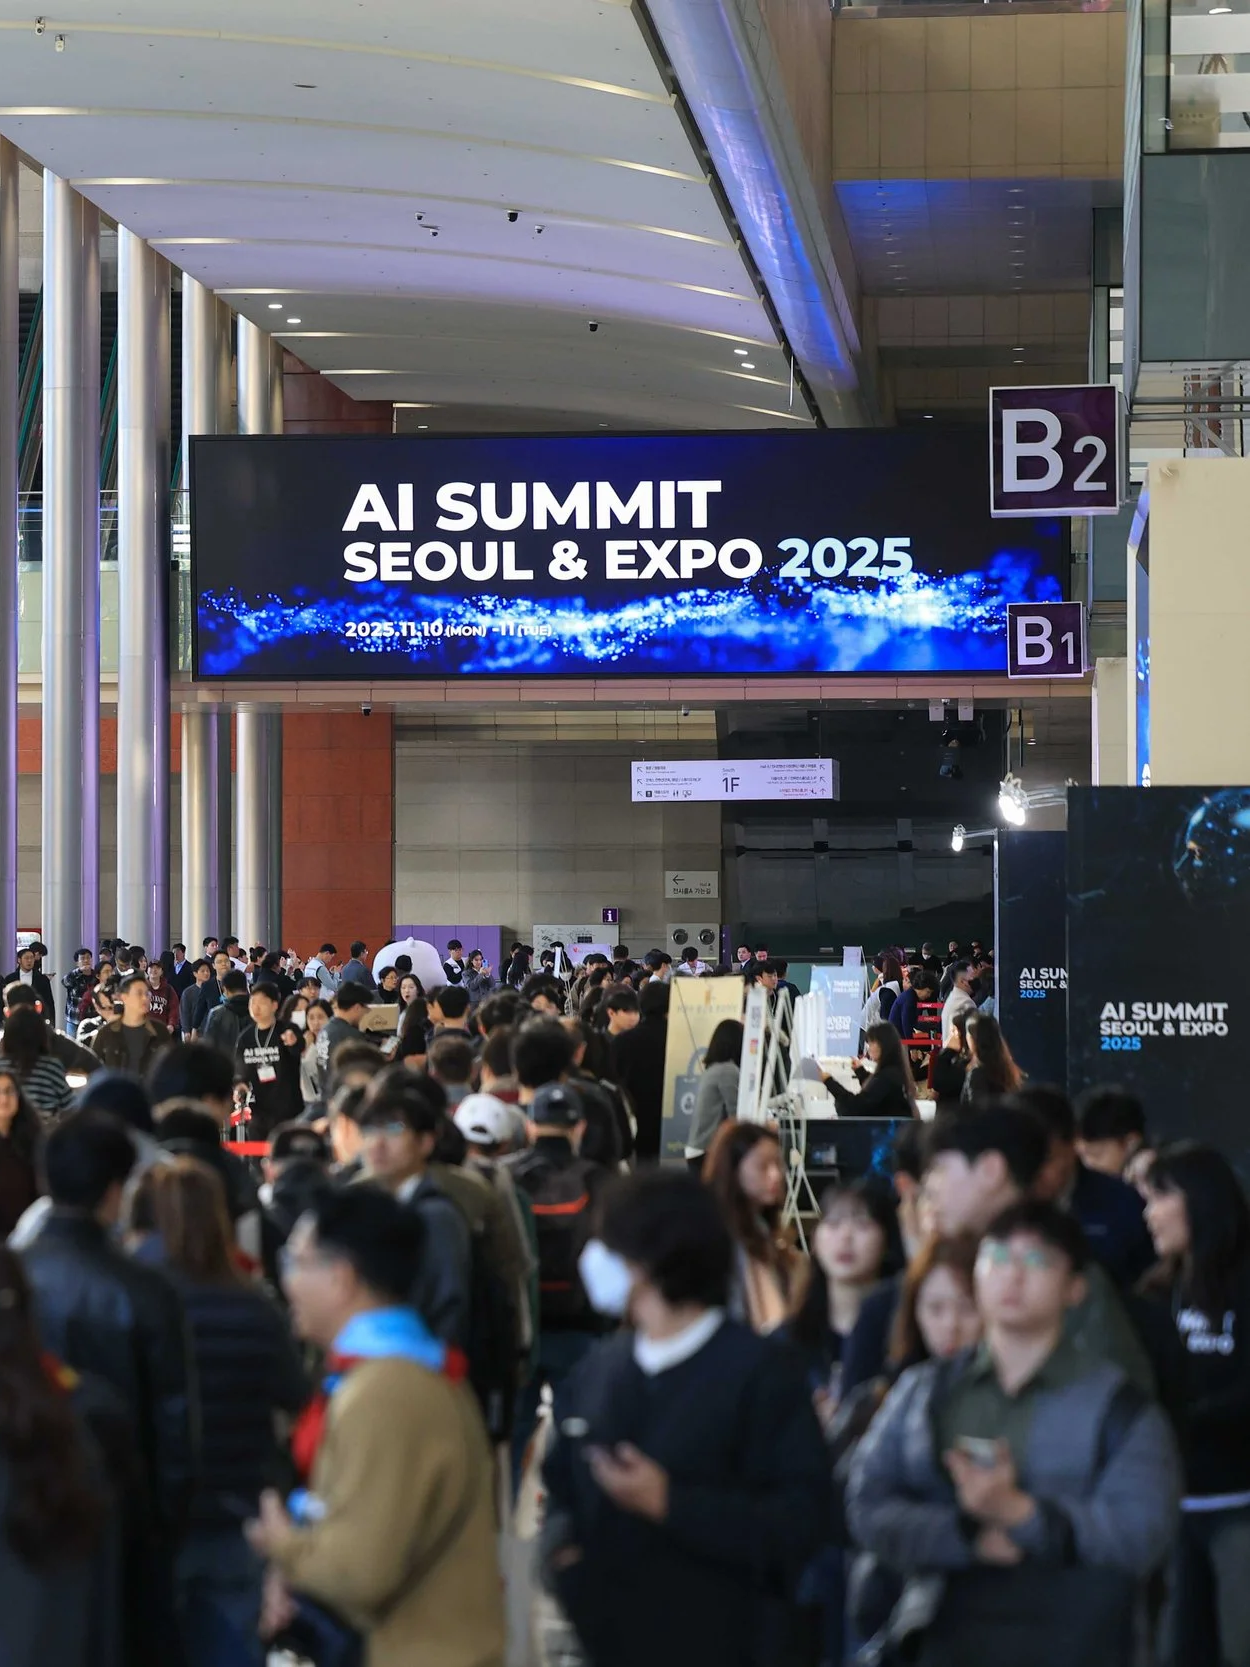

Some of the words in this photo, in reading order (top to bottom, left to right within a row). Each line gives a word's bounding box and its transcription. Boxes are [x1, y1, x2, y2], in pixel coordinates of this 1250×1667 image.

[1002, 408, 1107, 493] B2
[341, 482, 414, 532] AI
[435, 480, 722, 532] SUMMIT
[343, 540, 534, 583] SEOUL
[548, 539, 589, 581] &
[605, 539, 763, 580] EXPO
[777, 537, 913, 579] 2025
[1017, 615, 1075, 666] B1
[722, 777, 740, 792] 1F
[1019, 968, 1036, 979] AI
[1019, 980, 1058, 989] SEOUL
[1020, 989, 1046, 998] 2025
[1100, 1002, 1126, 1021] AI
[1131, 1001, 1229, 1021] SUMMIT
[1100, 1021, 1159, 1036] SEOUL
[1162, 1021, 1175, 1036] &
[1179, 1021, 1229, 1036] EXPO
[1100, 1036, 1142, 1050] 2025
